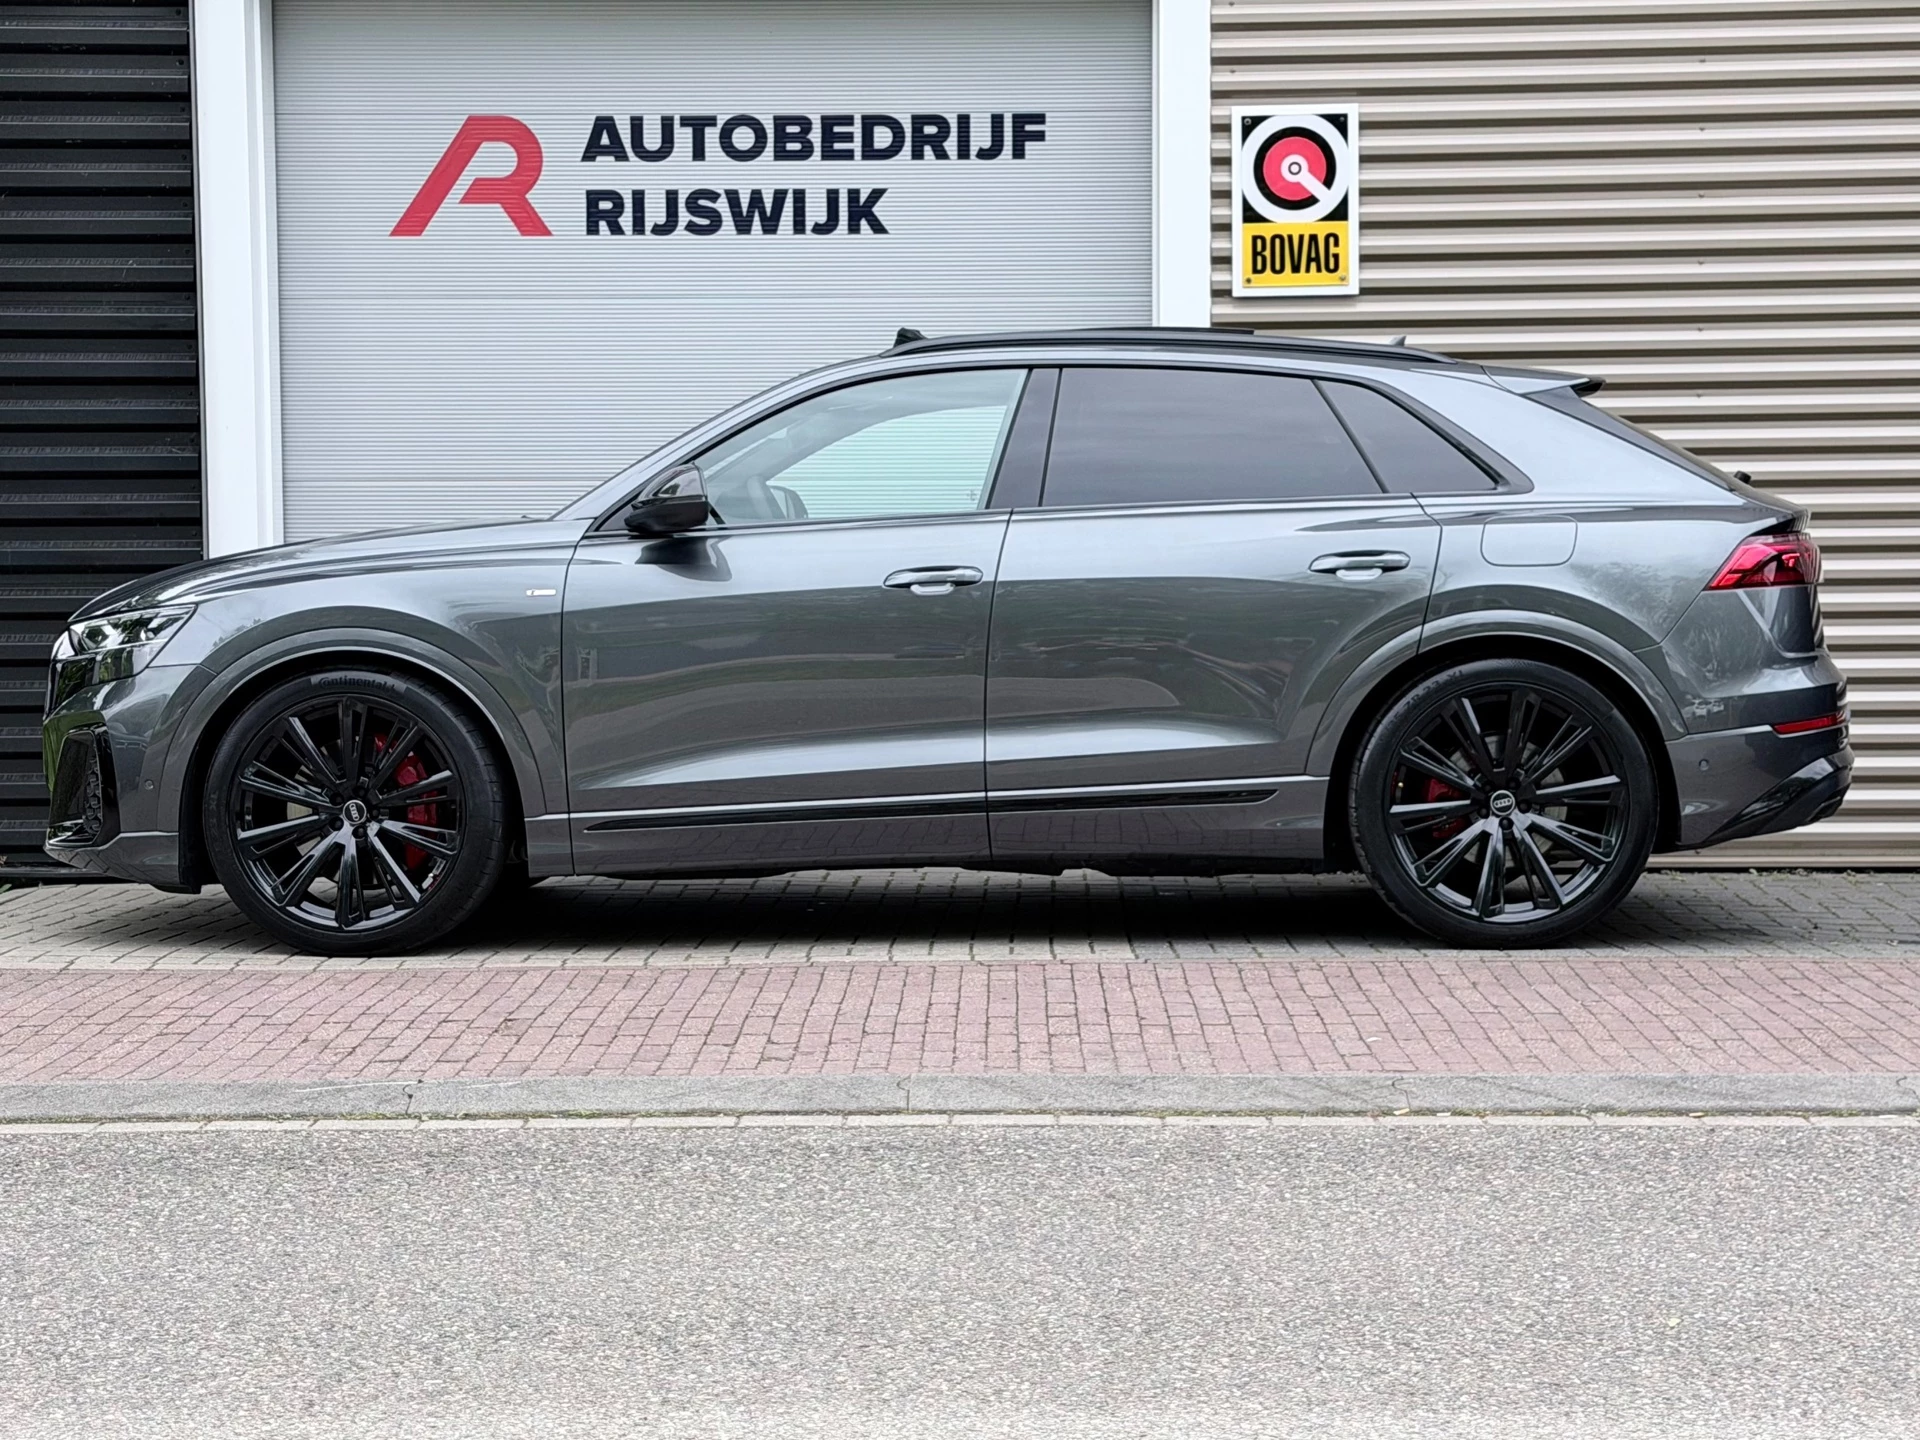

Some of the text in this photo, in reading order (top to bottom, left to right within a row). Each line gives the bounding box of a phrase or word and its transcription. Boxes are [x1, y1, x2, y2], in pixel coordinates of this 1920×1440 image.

[582, 113, 1047, 162] AUTOBEDRIJF
[585, 188, 889, 236] RIJSWIJK
[1251, 232, 1340, 275] BOVAG
[318, 675, 388, 690] Continental
